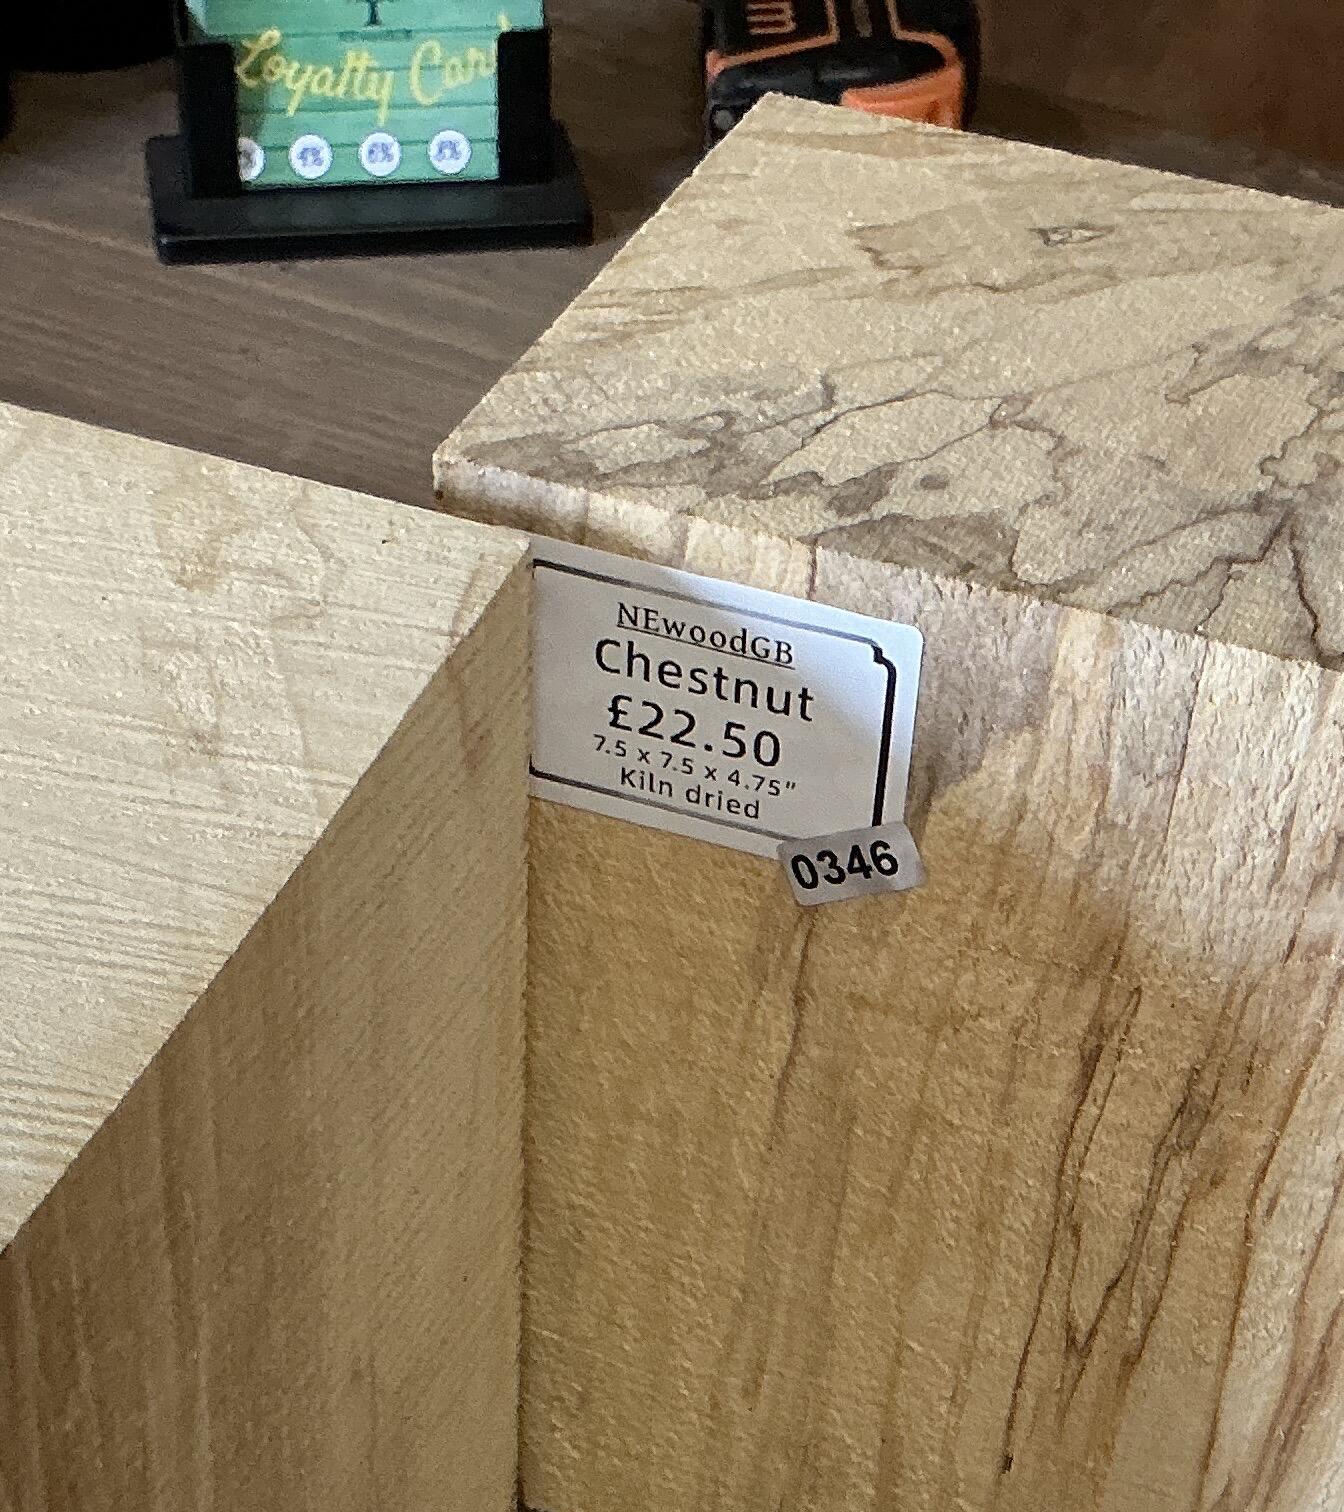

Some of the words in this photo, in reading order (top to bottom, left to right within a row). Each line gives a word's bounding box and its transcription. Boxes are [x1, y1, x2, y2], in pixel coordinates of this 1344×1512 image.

[234, 26, 394, 127] Loyalty
[410, 12, 511, 106] Car
[617, 602, 795, 665] NEwoodGB
[595, 639, 815, 721] Chestnut
[592, 734, 627, 757] 7.5
[661, 751, 693, 775] 7.5
[608, 694, 781, 767] £22.50
[620, 767, 673, 799] Kiln
[686, 783, 760, 820] dried
[791, 839, 899, 890] 0346
